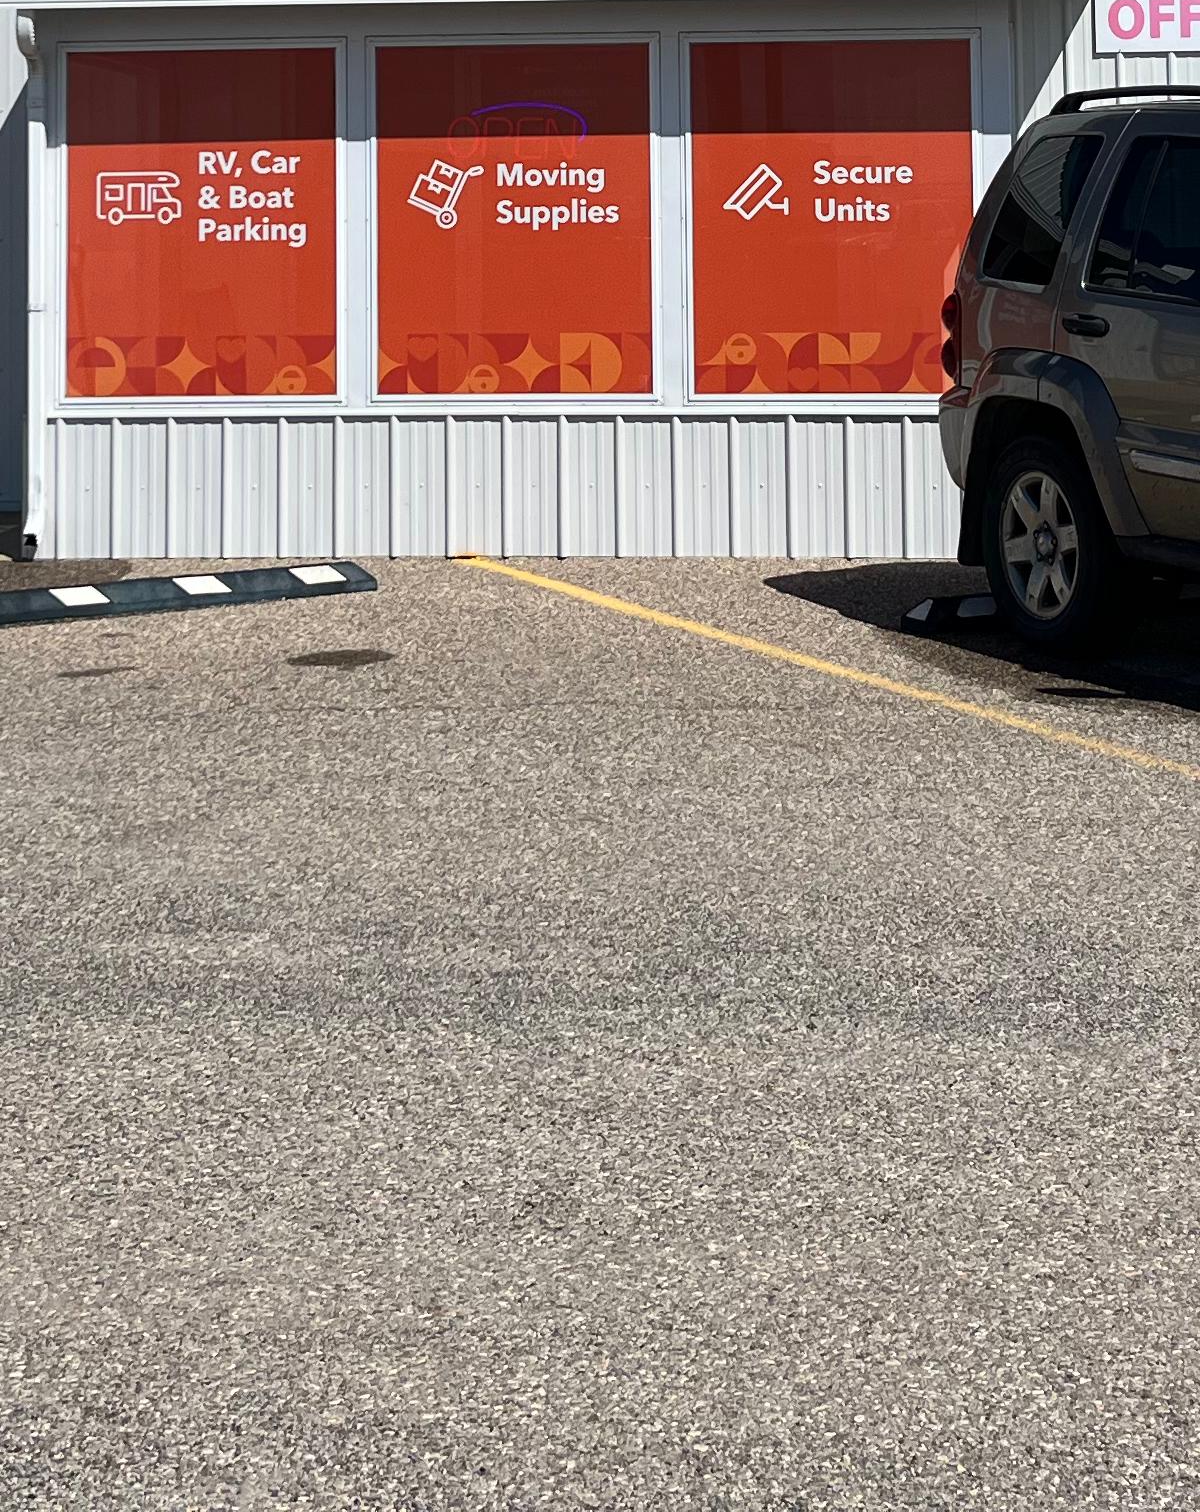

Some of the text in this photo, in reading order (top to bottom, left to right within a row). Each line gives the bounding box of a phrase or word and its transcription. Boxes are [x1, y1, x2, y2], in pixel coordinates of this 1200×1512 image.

[447, 116, 577, 160] OPEN
[198, 149, 301, 178] RV, Car
[496, 161, 605, 193] Moving
[813, 160, 914, 185] Secure
[198, 185, 295, 210] & Boat
[814, 196, 891, 223] Units
[495, 198, 620, 231] Supplies
[198, 216, 307, 248] Parking
